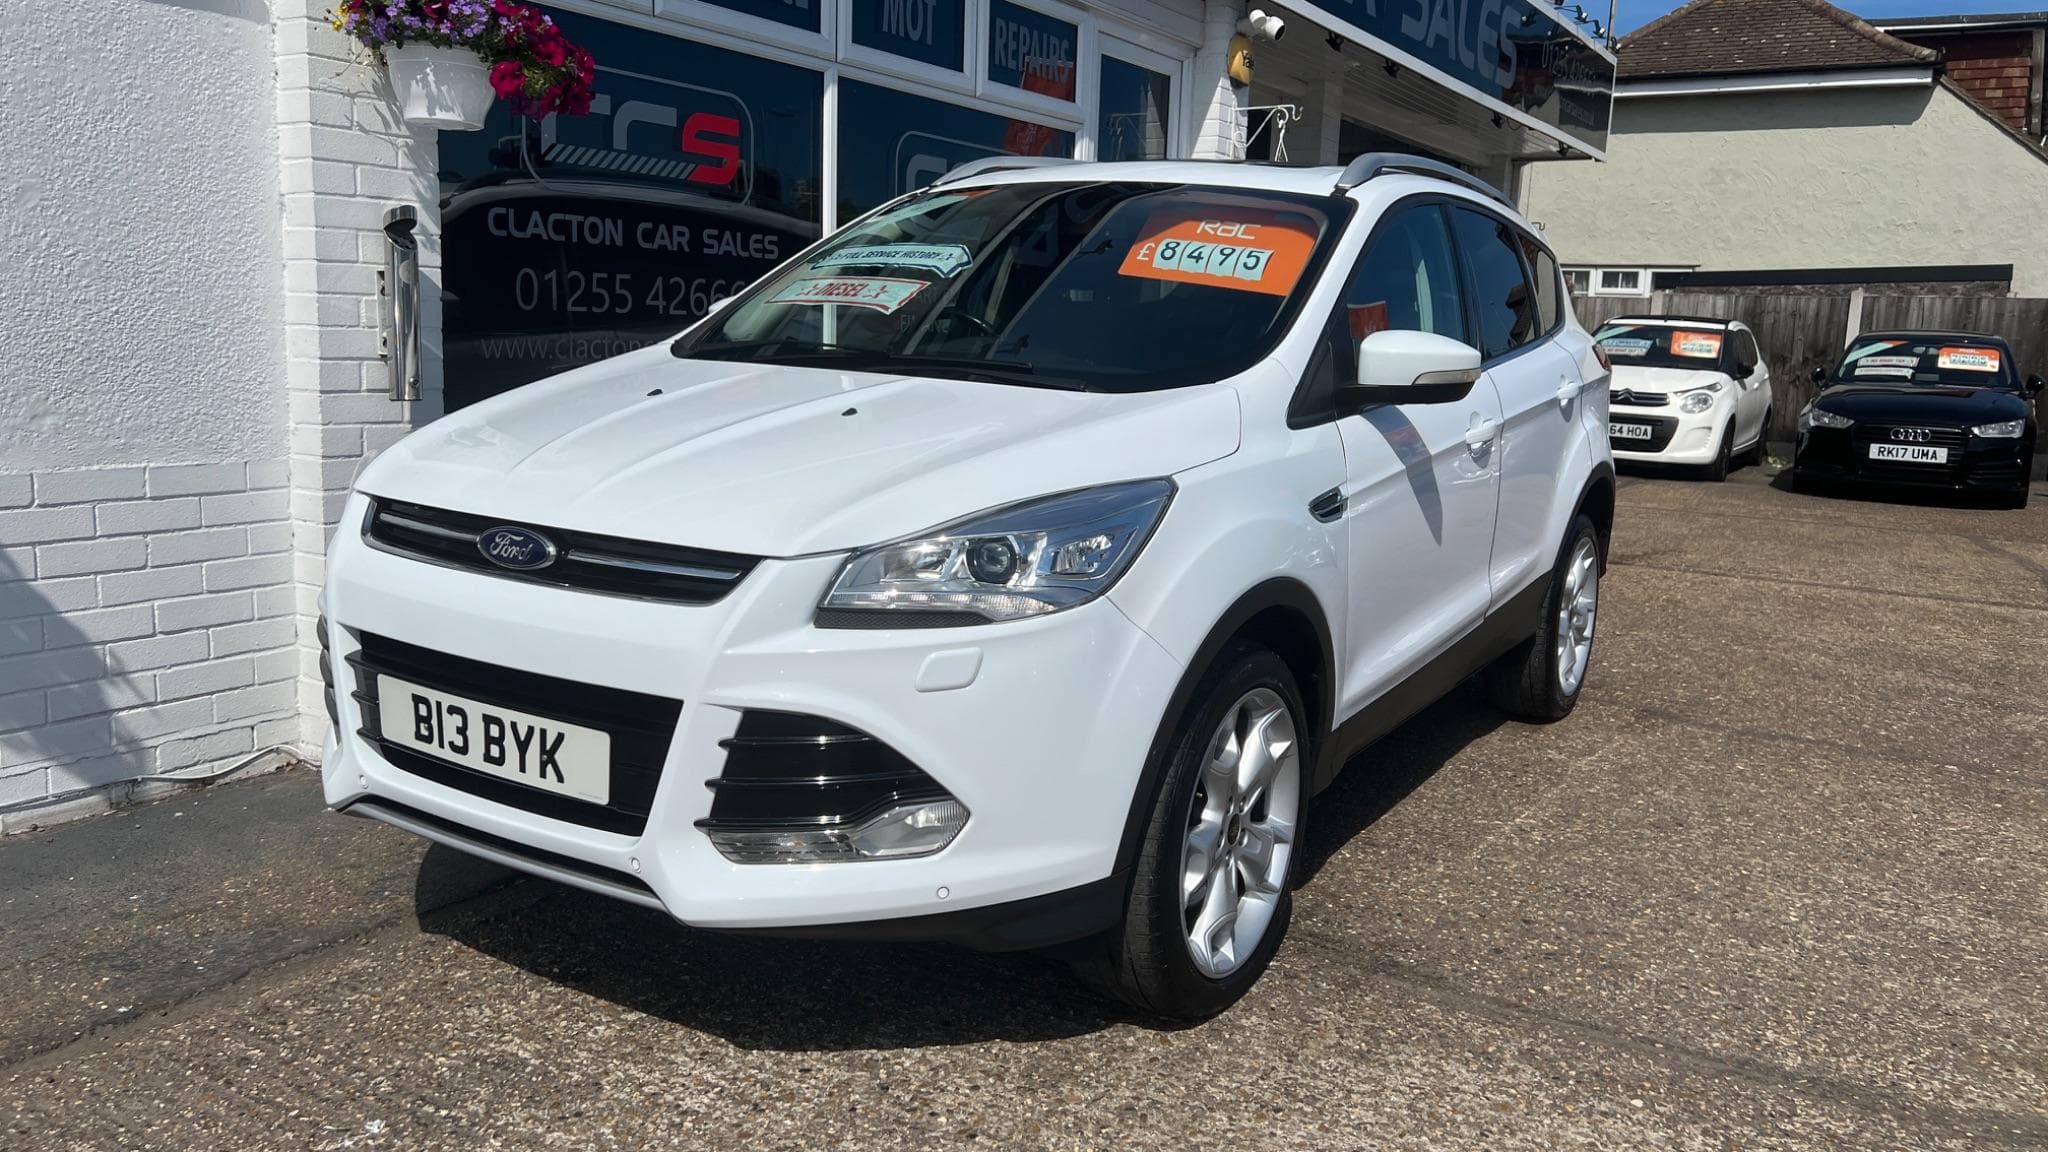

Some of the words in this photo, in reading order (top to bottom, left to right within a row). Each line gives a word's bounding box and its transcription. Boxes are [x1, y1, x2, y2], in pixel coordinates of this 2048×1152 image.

[882, 0, 937, 46] MOT
[994, 17, 1071, 83] REPAIRS
[487, 206, 623, 248] CLACTON
[636, 221, 691, 252] CAR
[702, 228, 779, 260] SALES
[862, 249, 902, 260] SERVICE
[901, 250, 941, 261] HISTORY
[515, 267, 633, 315] 01255
[814, 282, 870, 298] DIESEL
[1626, 425, 1649, 438] HOA
[1877, 446, 1907, 459] RK17
[1911, 448, 1938, 461] UMA
[489, 531, 534, 561] Ford
[411, 692, 469, 757] B13
[481, 712, 566, 785] BYK
